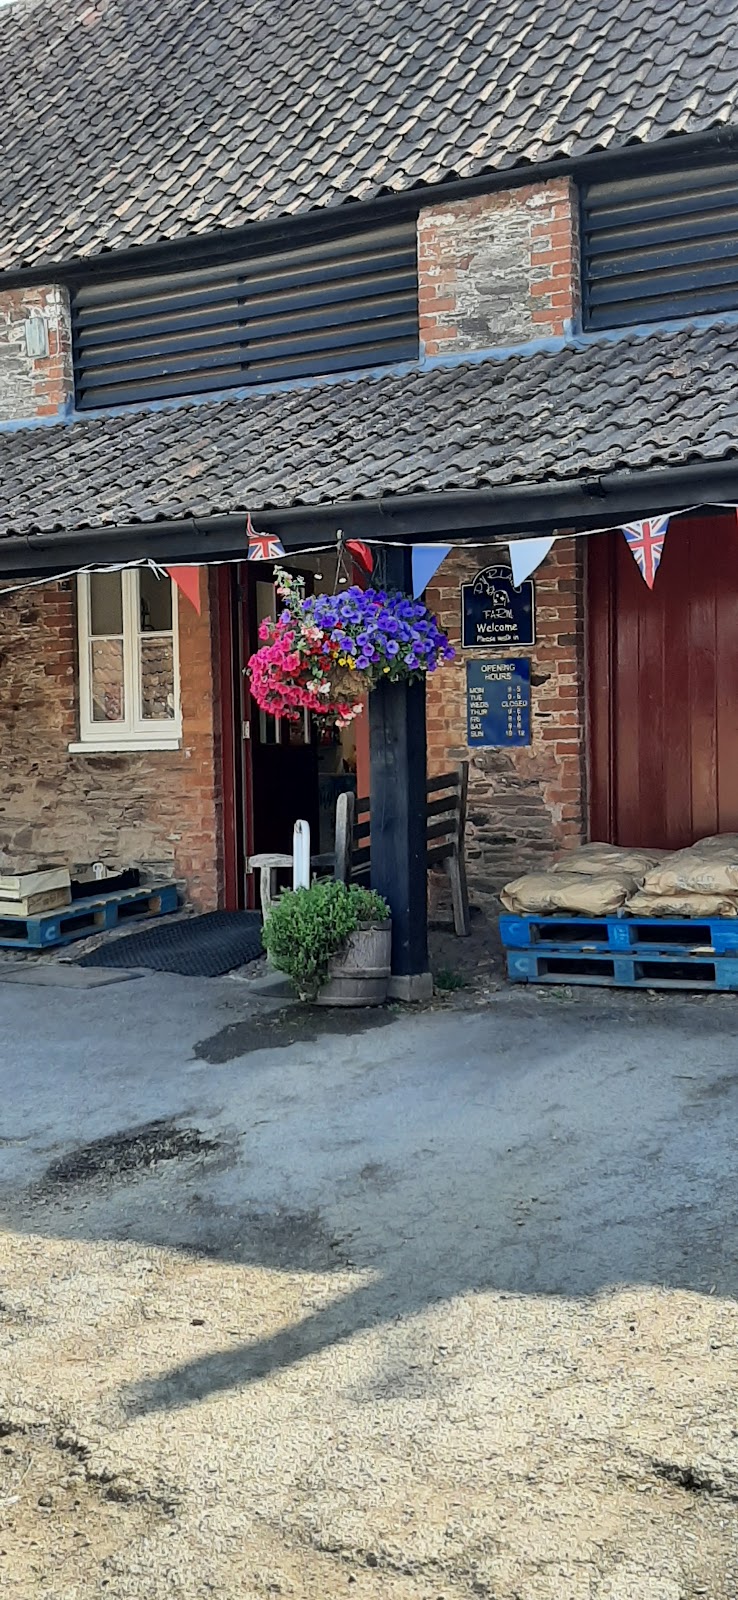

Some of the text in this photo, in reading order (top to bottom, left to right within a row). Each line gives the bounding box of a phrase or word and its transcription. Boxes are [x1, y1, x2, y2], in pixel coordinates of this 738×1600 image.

[482, 608, 514, 619] FARM
[476, 622, 518, 633] Welcome
[476, 634, 496, 642] Please
[497, 633, 512, 641] walk
[481, 663, 516, 673] OPENING
[484, 672, 512, 681] HOURS
